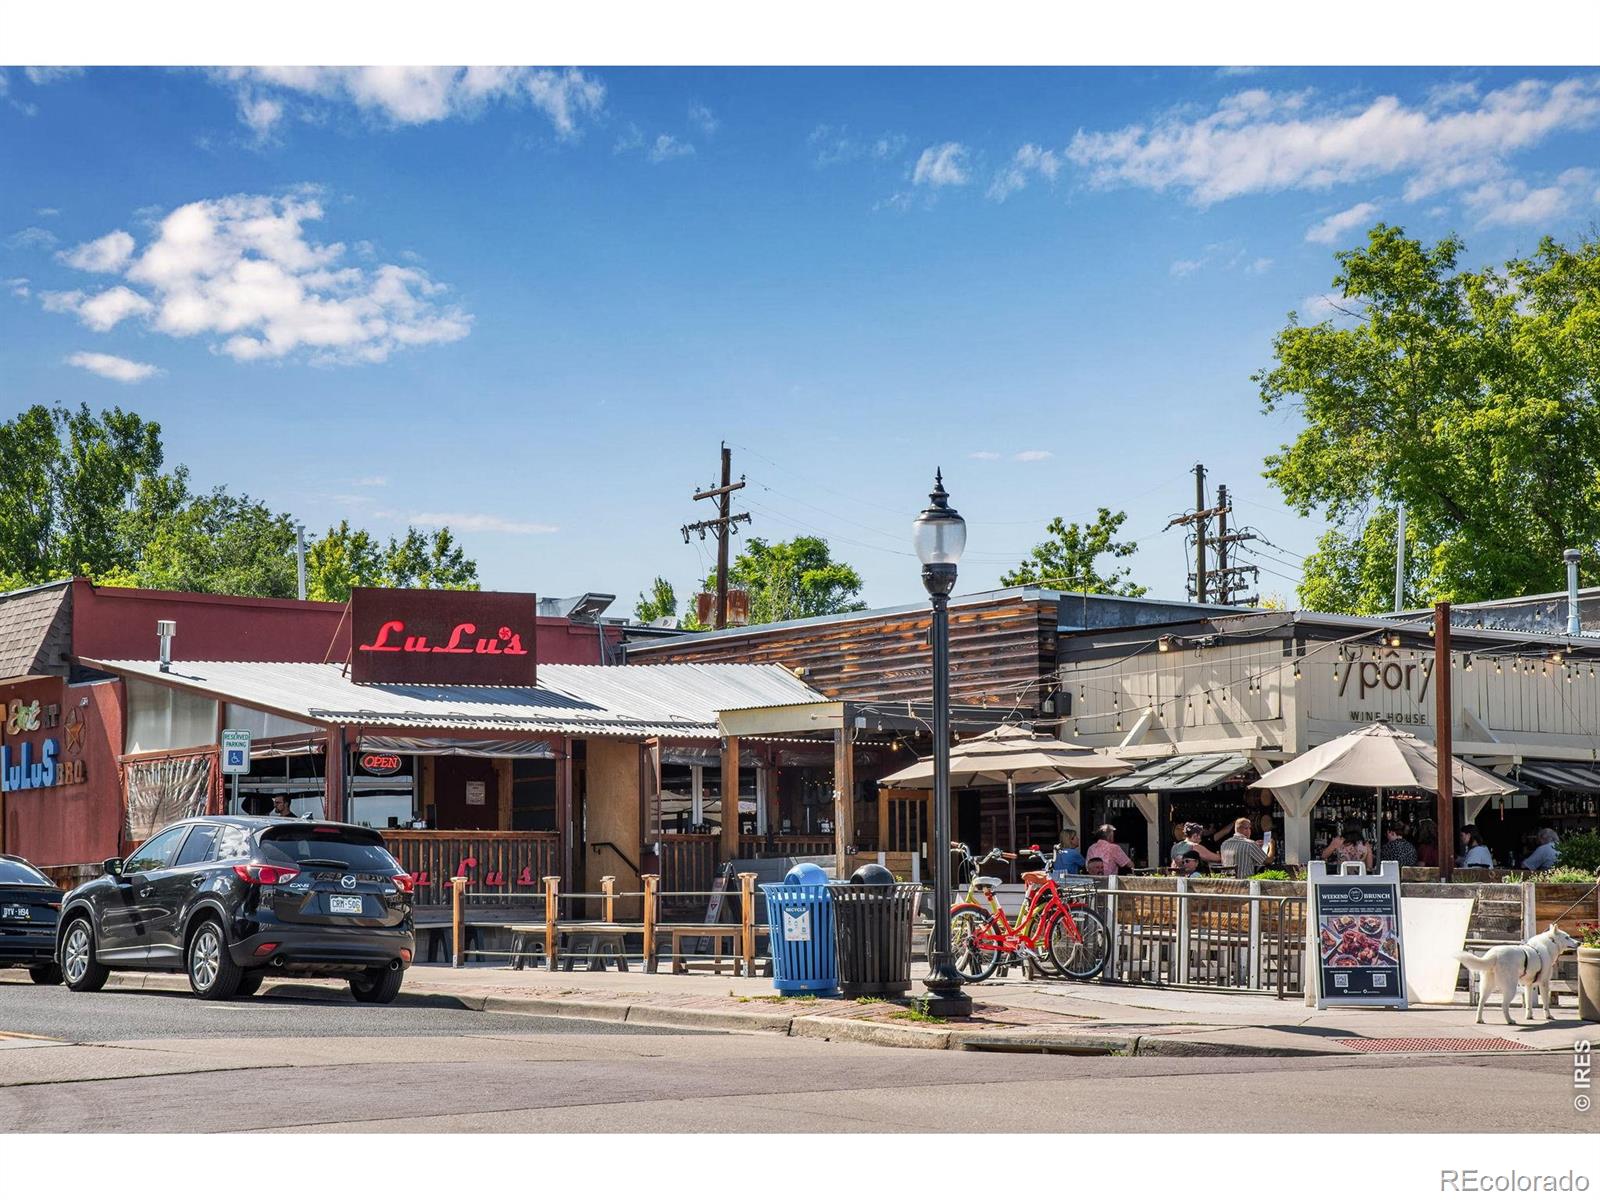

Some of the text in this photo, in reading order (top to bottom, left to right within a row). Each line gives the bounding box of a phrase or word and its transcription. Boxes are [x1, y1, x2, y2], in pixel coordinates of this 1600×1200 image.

[1350, 711, 1426, 724] WINE HOUSE
[364, 756, 397, 768] OPEN
[56, 760, 87, 785] BBQ
